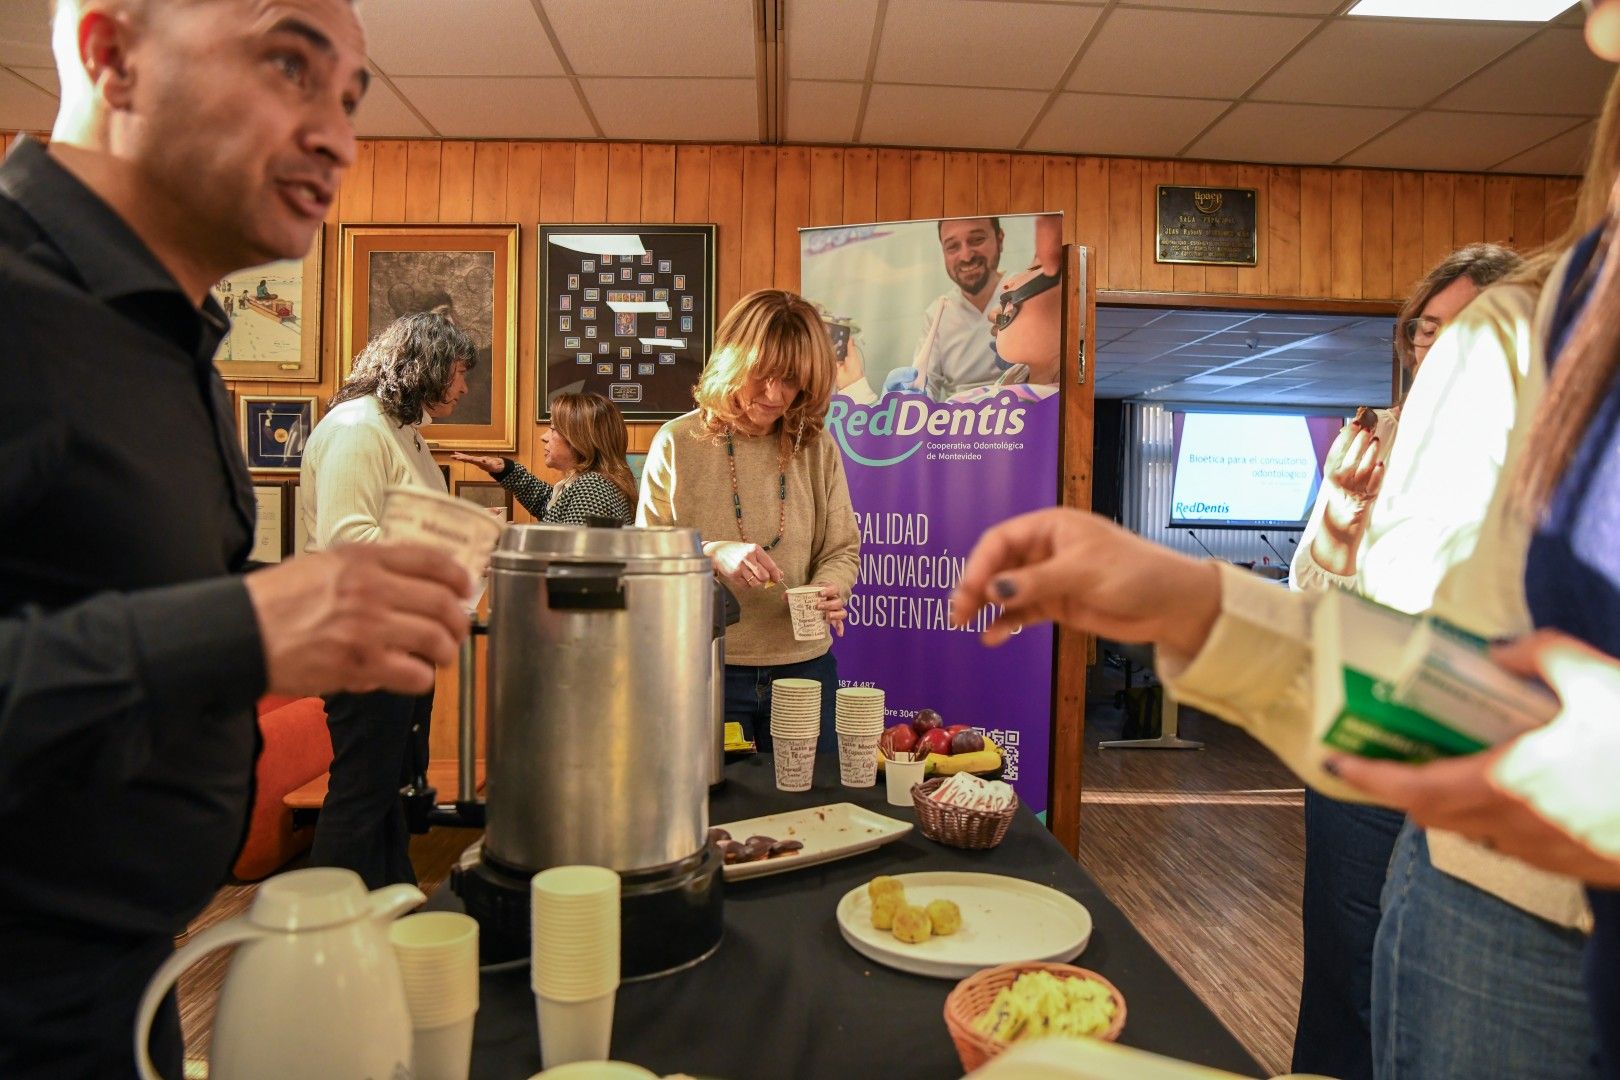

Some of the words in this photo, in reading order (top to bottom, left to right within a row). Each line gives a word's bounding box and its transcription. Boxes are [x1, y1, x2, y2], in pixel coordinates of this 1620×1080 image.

[824, 396, 1026, 437] RedDentis
[926, 441, 971, 451] Cooperativa
[973, 441, 1024, 451] Odontológica
[926, 452, 936, 460] de
[938, 452, 982, 460] Montevideo
[1227, 456, 1247, 465] para
[1175, 502, 1230, 514] RedDentis
[855, 549, 966, 589] NNOVACIÓN
